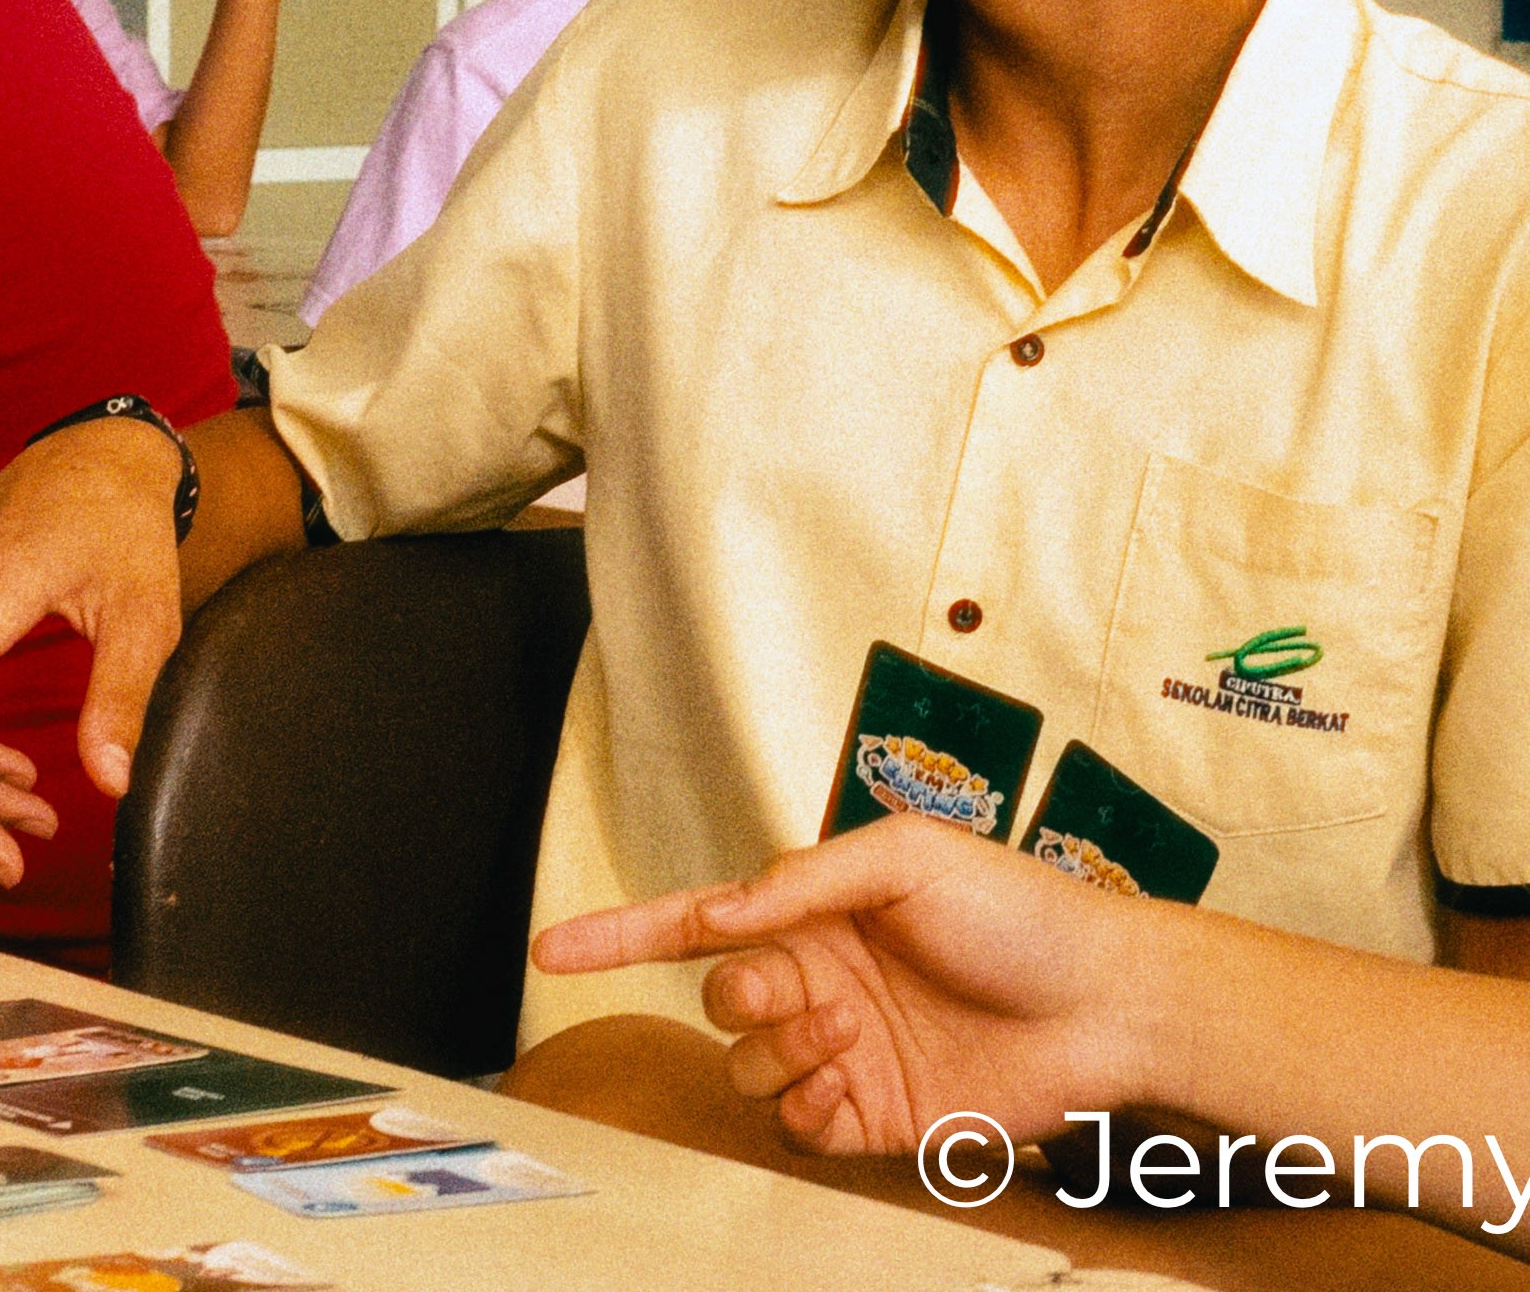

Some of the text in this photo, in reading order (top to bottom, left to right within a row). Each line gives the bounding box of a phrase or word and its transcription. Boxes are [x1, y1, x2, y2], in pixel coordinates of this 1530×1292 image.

[1161, 677, 1350, 733] SEKOLAH CITRA BERKAT
[1225, 676, 1300, 704] CIPUTRA
